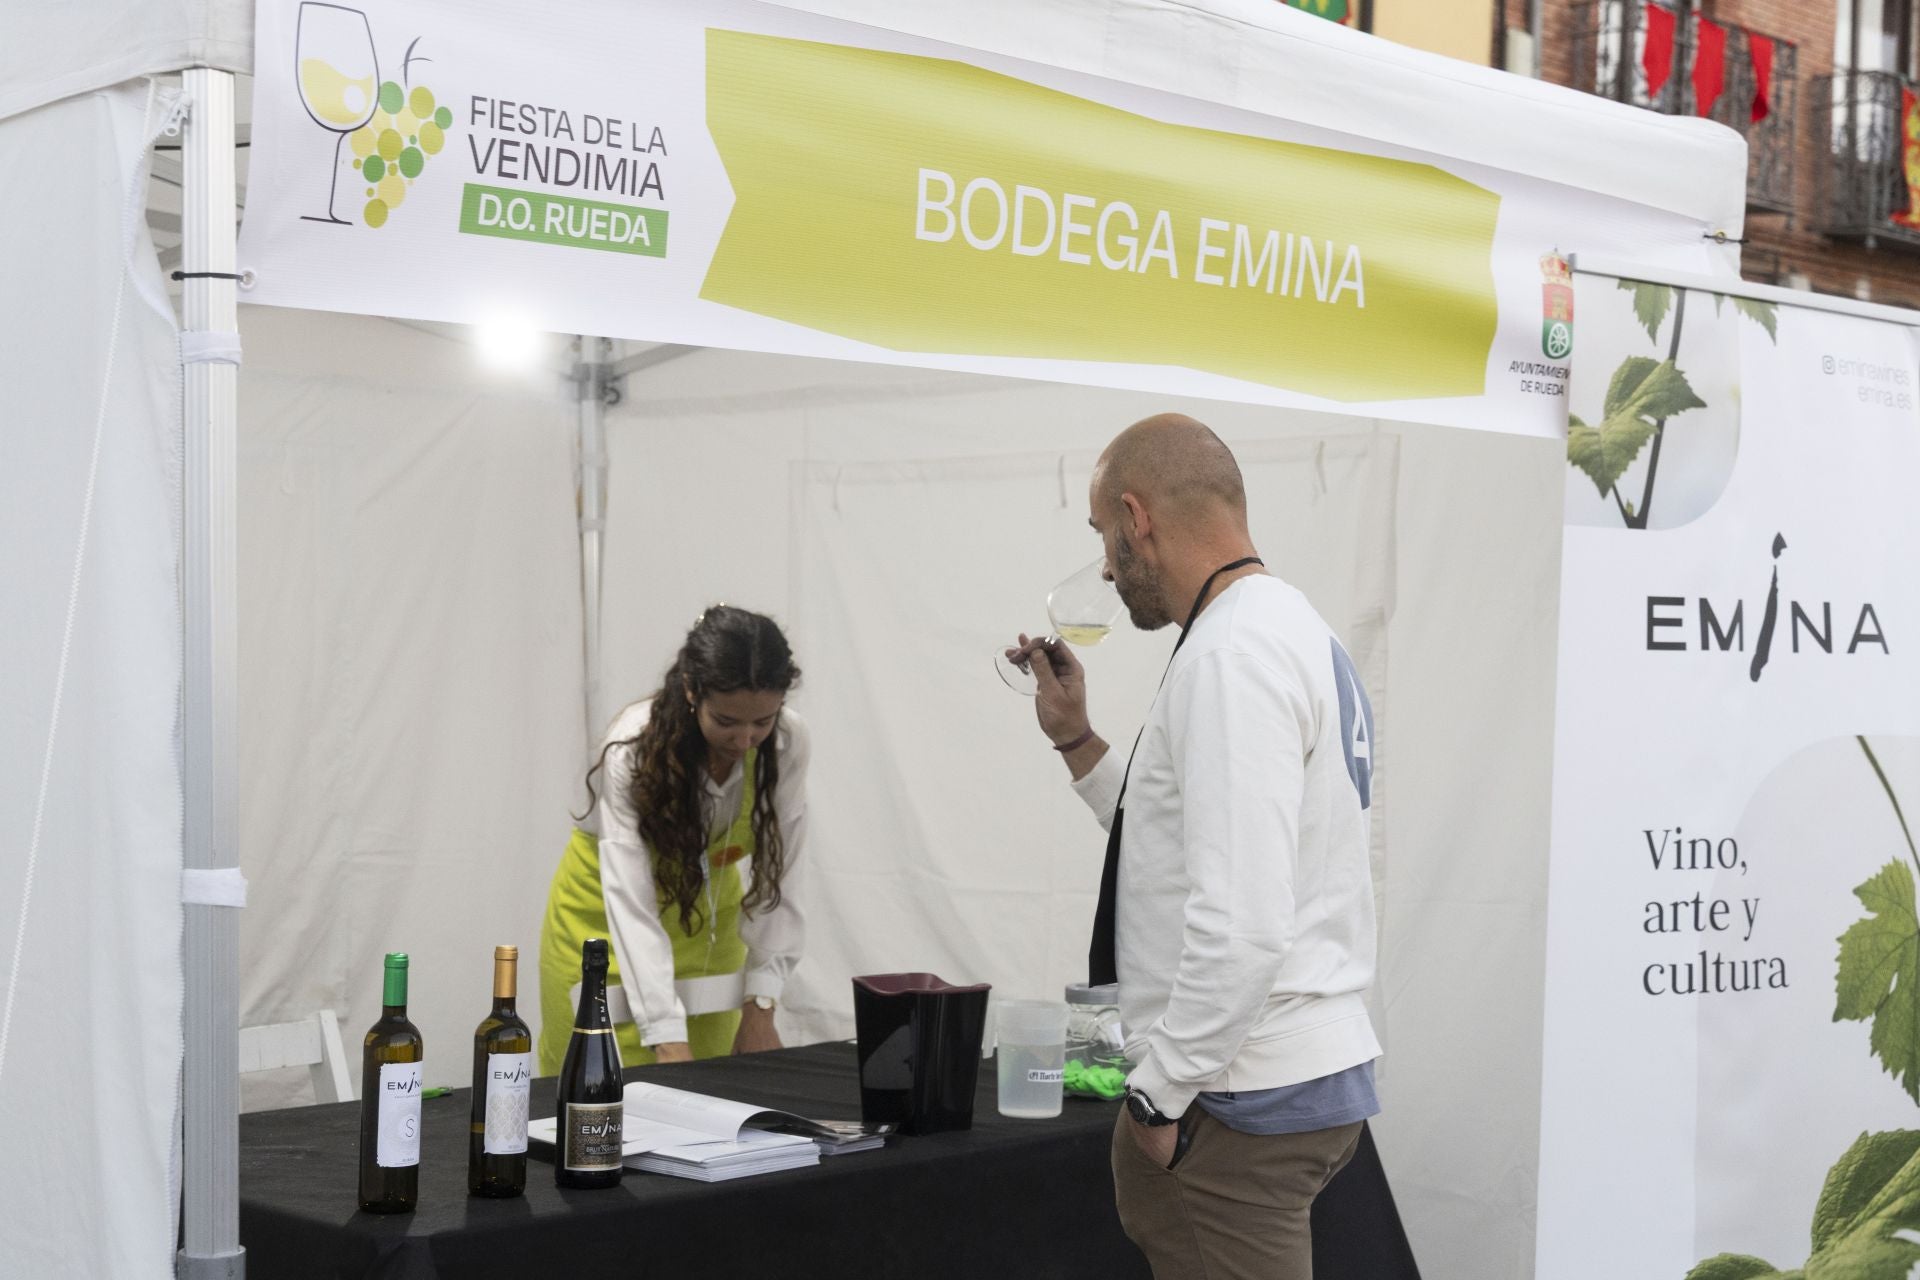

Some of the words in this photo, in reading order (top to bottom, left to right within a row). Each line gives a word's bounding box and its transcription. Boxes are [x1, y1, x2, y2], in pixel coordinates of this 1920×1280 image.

[470, 95, 575, 142] FIESTA
[583, 114, 625, 149] DE
[631, 122, 668, 156] LA
[468, 133, 665, 201] VENDIMIA
[477, 192, 536, 232] D.O.
[544, 201, 651, 247] RUEDA
[915, 167, 1179, 279] BODEGA
[1194, 217, 1366, 308] EMINA
[1521, 380, 1533, 392] DE
[1535, 381, 1564, 395] RUEDA
[1642, 826, 1748, 876] Vino,
[1643, 891, 1731, 934] arte
[1741, 898, 1761, 942] y
[1642, 949, 1790, 996] cultura
